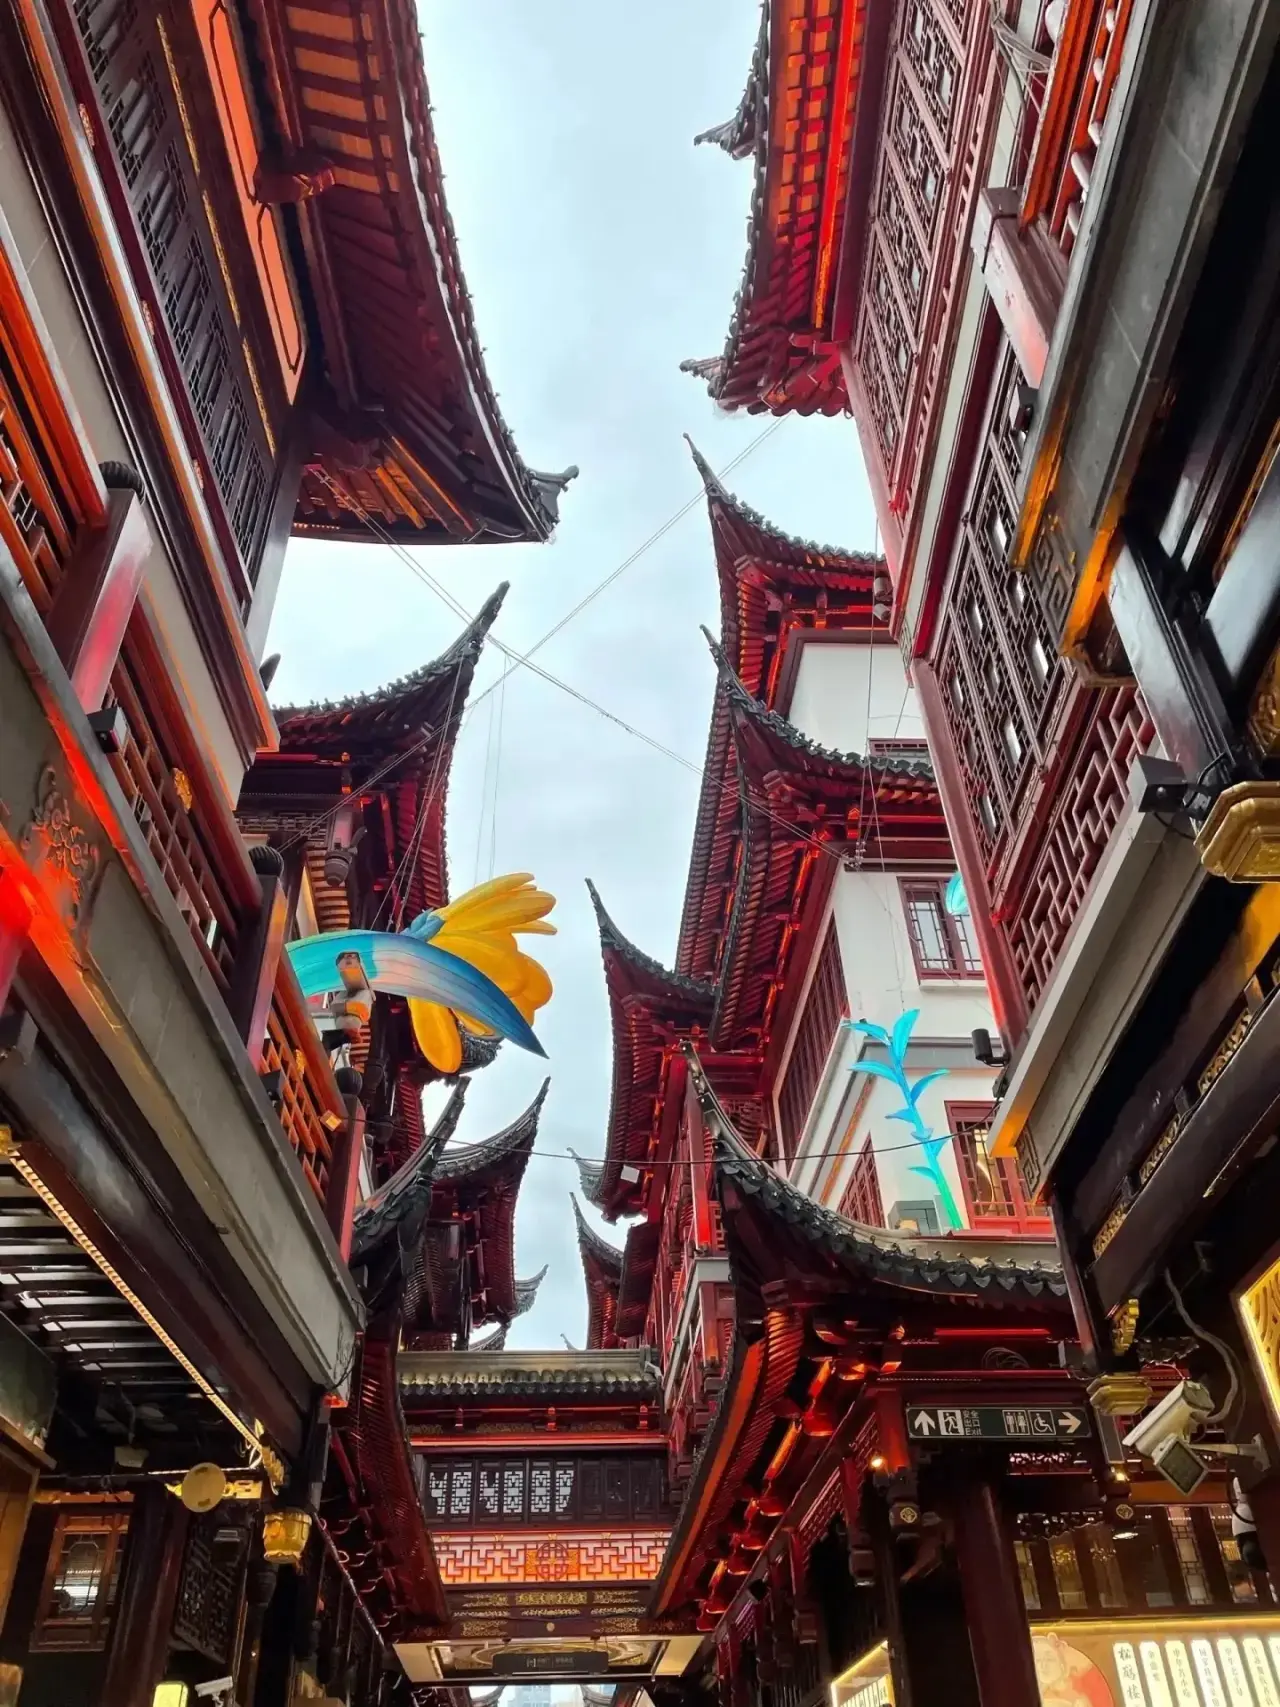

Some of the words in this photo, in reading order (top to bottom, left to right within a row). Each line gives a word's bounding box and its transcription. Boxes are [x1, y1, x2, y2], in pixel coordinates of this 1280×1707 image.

[963, 1410, 979, 1419] 安全
[964, 1419, 980, 1427] 出口
[965, 1428, 982, 1436] Exit
